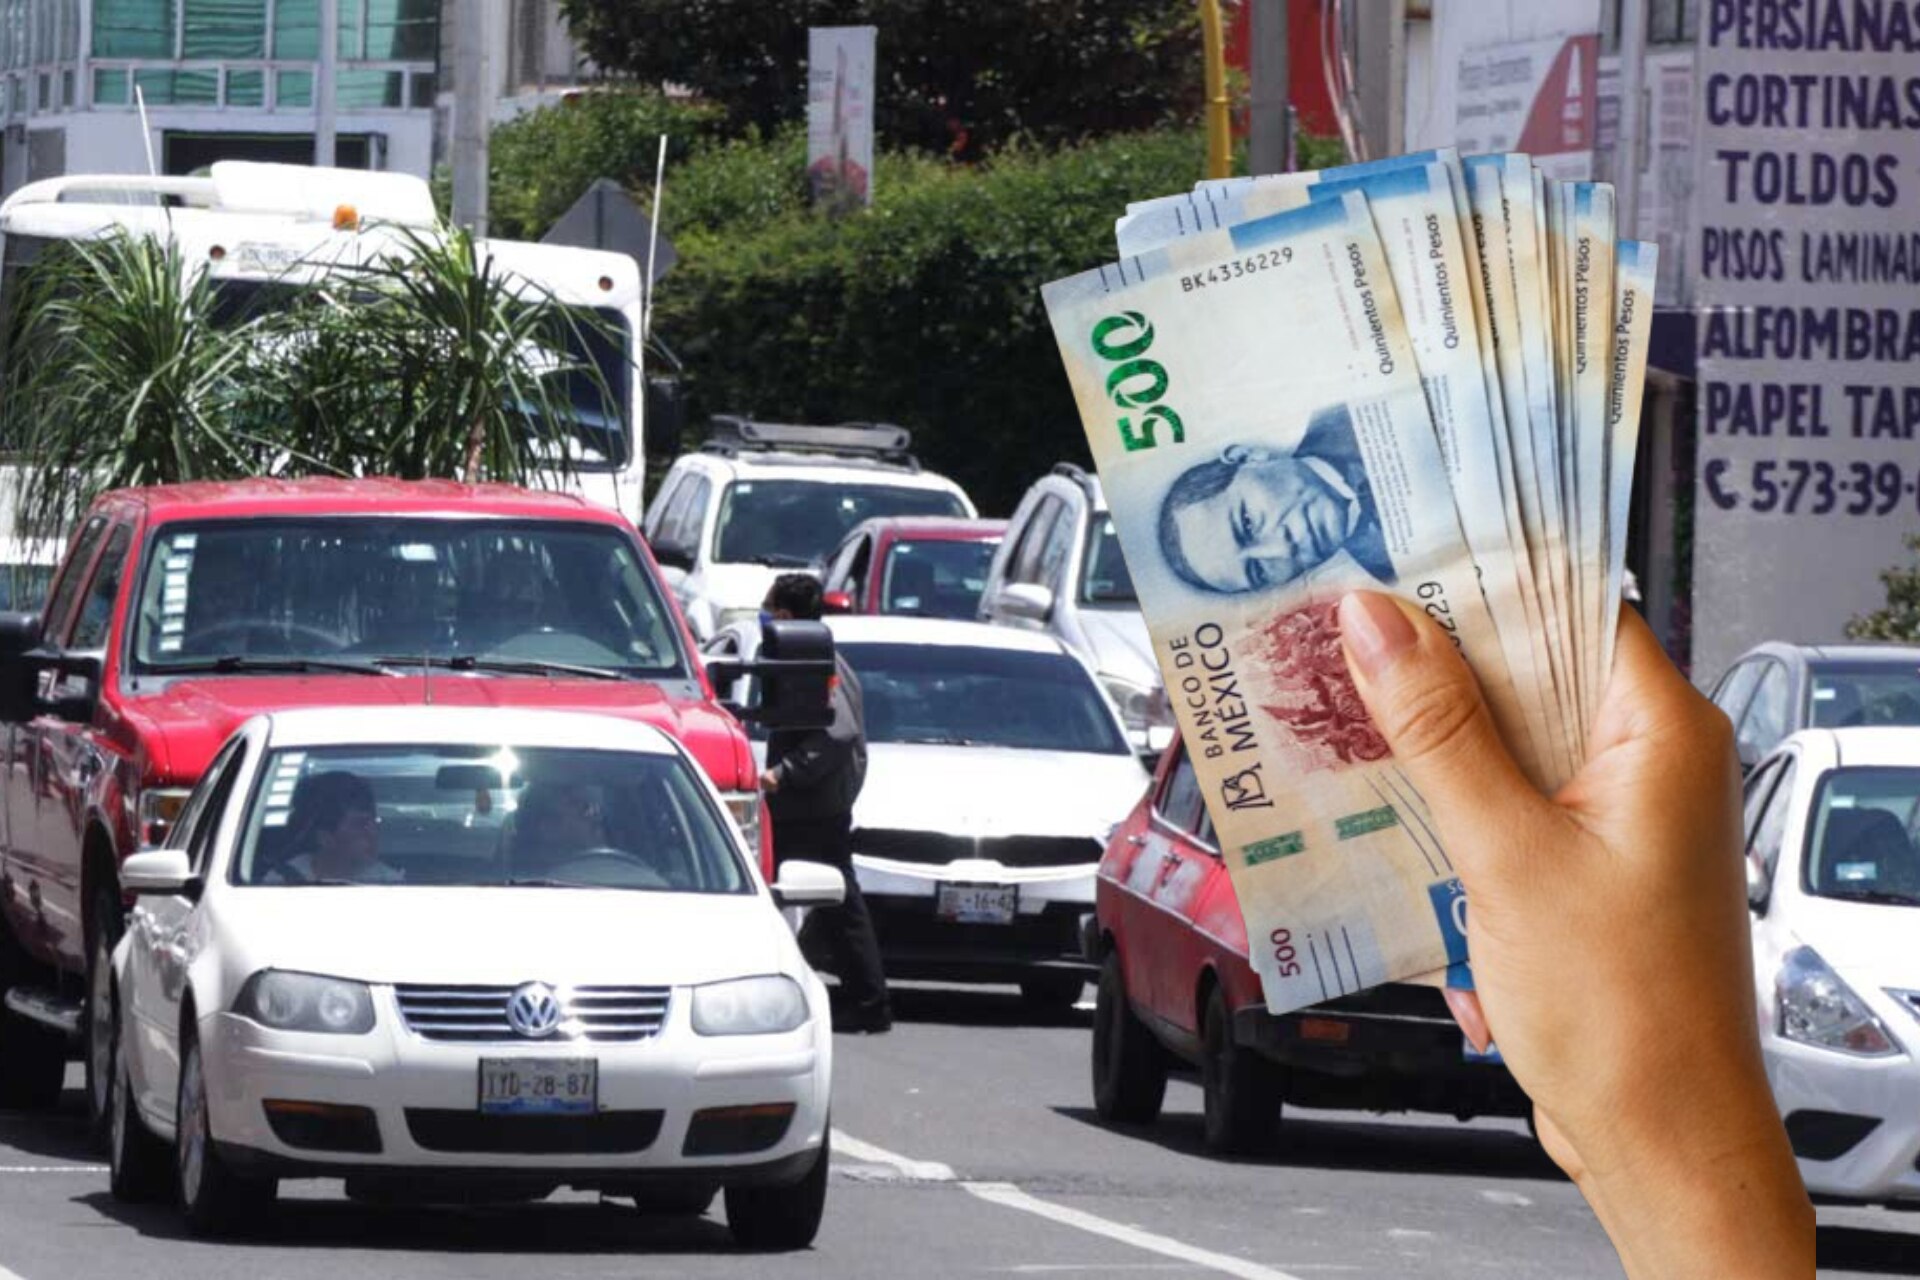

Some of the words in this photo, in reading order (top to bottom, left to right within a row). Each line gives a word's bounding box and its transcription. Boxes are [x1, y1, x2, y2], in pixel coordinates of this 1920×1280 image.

[1707, 73, 1920, 129] CORTINAS
[1716, 150, 1899, 208] TOLDOS
[1425, 213, 1443, 259] Pesos
[1702, 226, 1785, 281] PISOS
[1181, 247, 1293, 292] BK4336229
[1346, 242, 1368, 289] Pesos
[1360, 290, 1394, 375] Quinientos
[1432, 262, 1459, 349] Quinientos
[1091, 310, 1185, 452] 500
[1706, 381, 1828, 437] PAPEL
[1170, 636, 1194, 669] DE
[1194, 622, 1259, 752] MÉXICO
[1182, 676, 1225, 759] BANCO
[1270, 928, 1302, 978] 500
